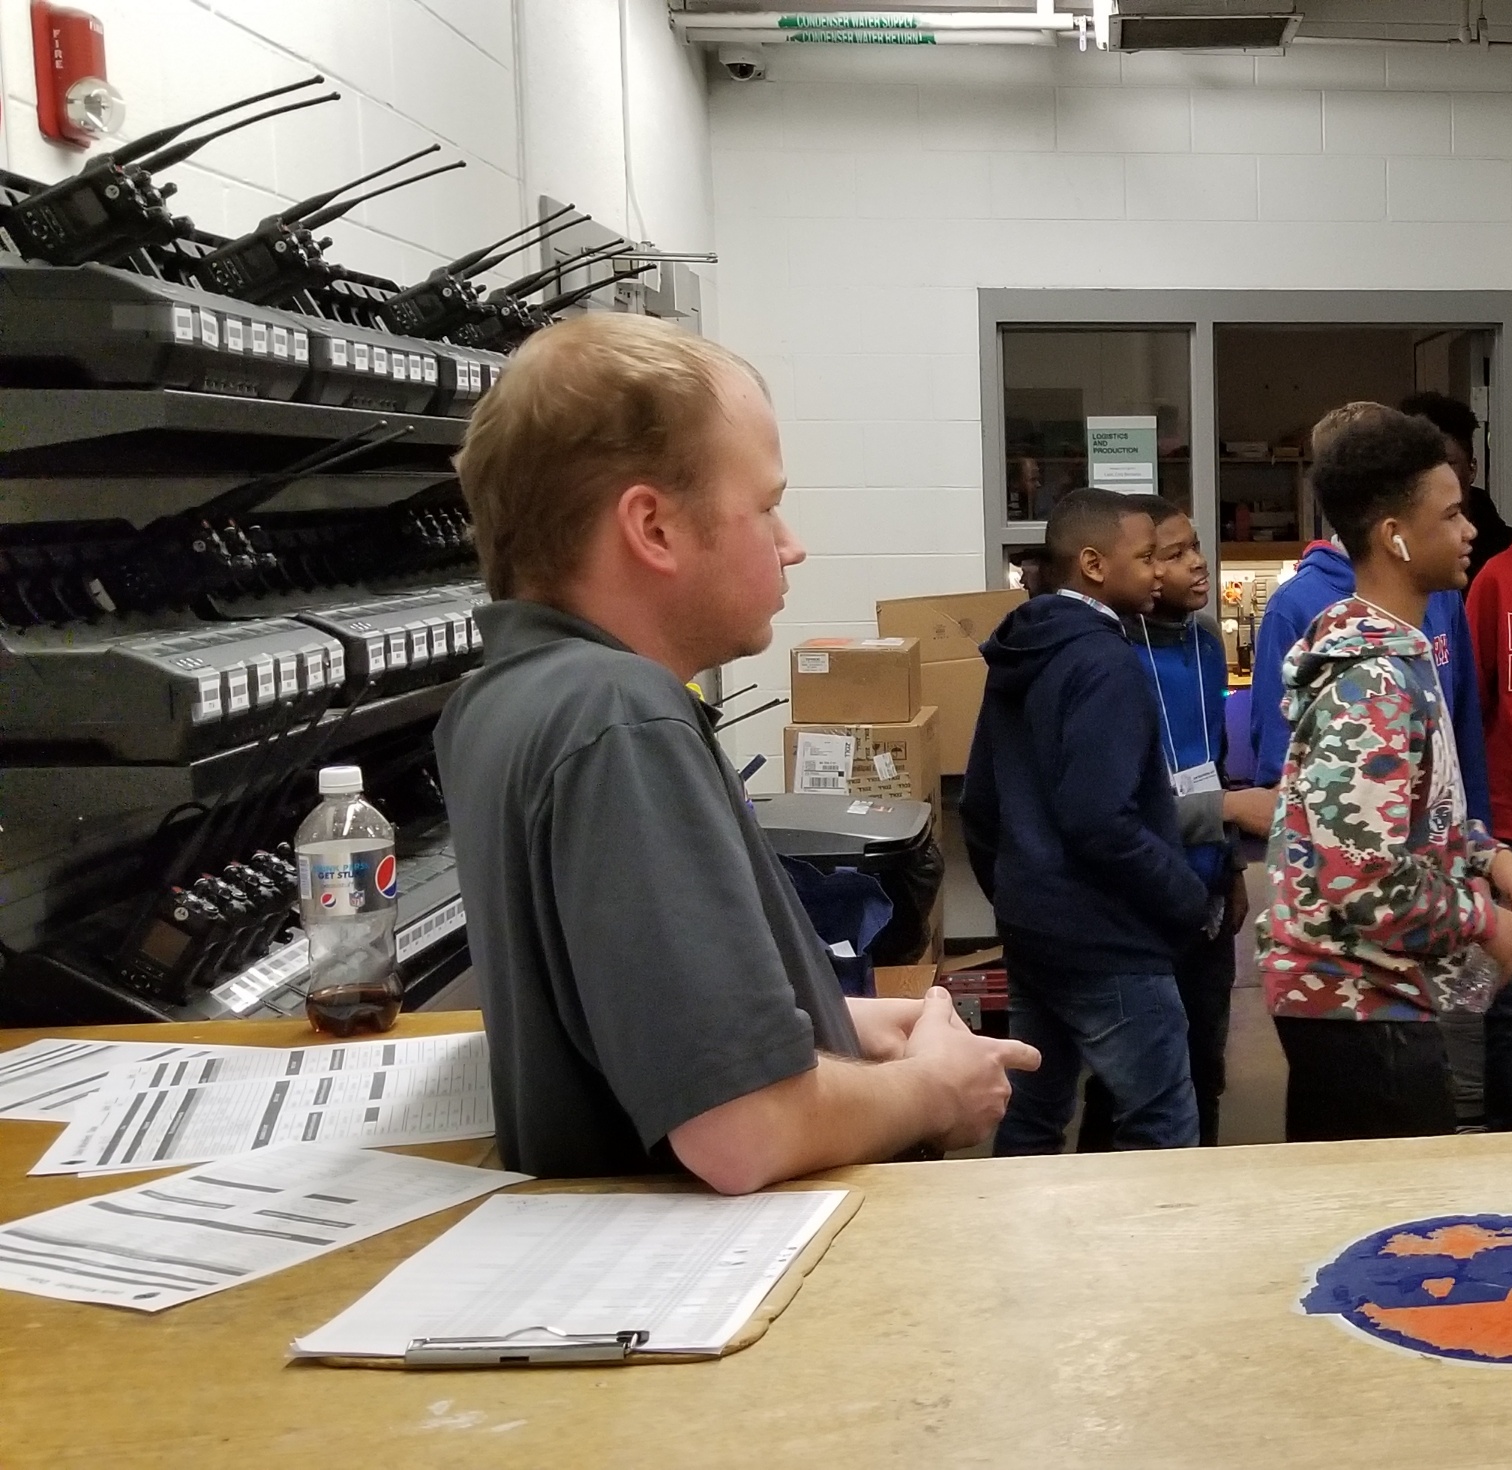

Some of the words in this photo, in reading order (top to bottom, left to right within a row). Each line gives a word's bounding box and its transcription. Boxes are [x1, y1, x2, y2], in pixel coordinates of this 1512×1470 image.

[796, 14, 849, 28] CONDENSER
[851, 14, 882, 28] WATER
[882, 14, 914, 28] SUPPLY
[801, 31, 854, 44] CONDENSER
[855, 31, 883, 44] WATER
[883, 31, 918, 44] RETURN
[52, 28, 64, 69] FIRE
[317, 871, 335, 879] GET
